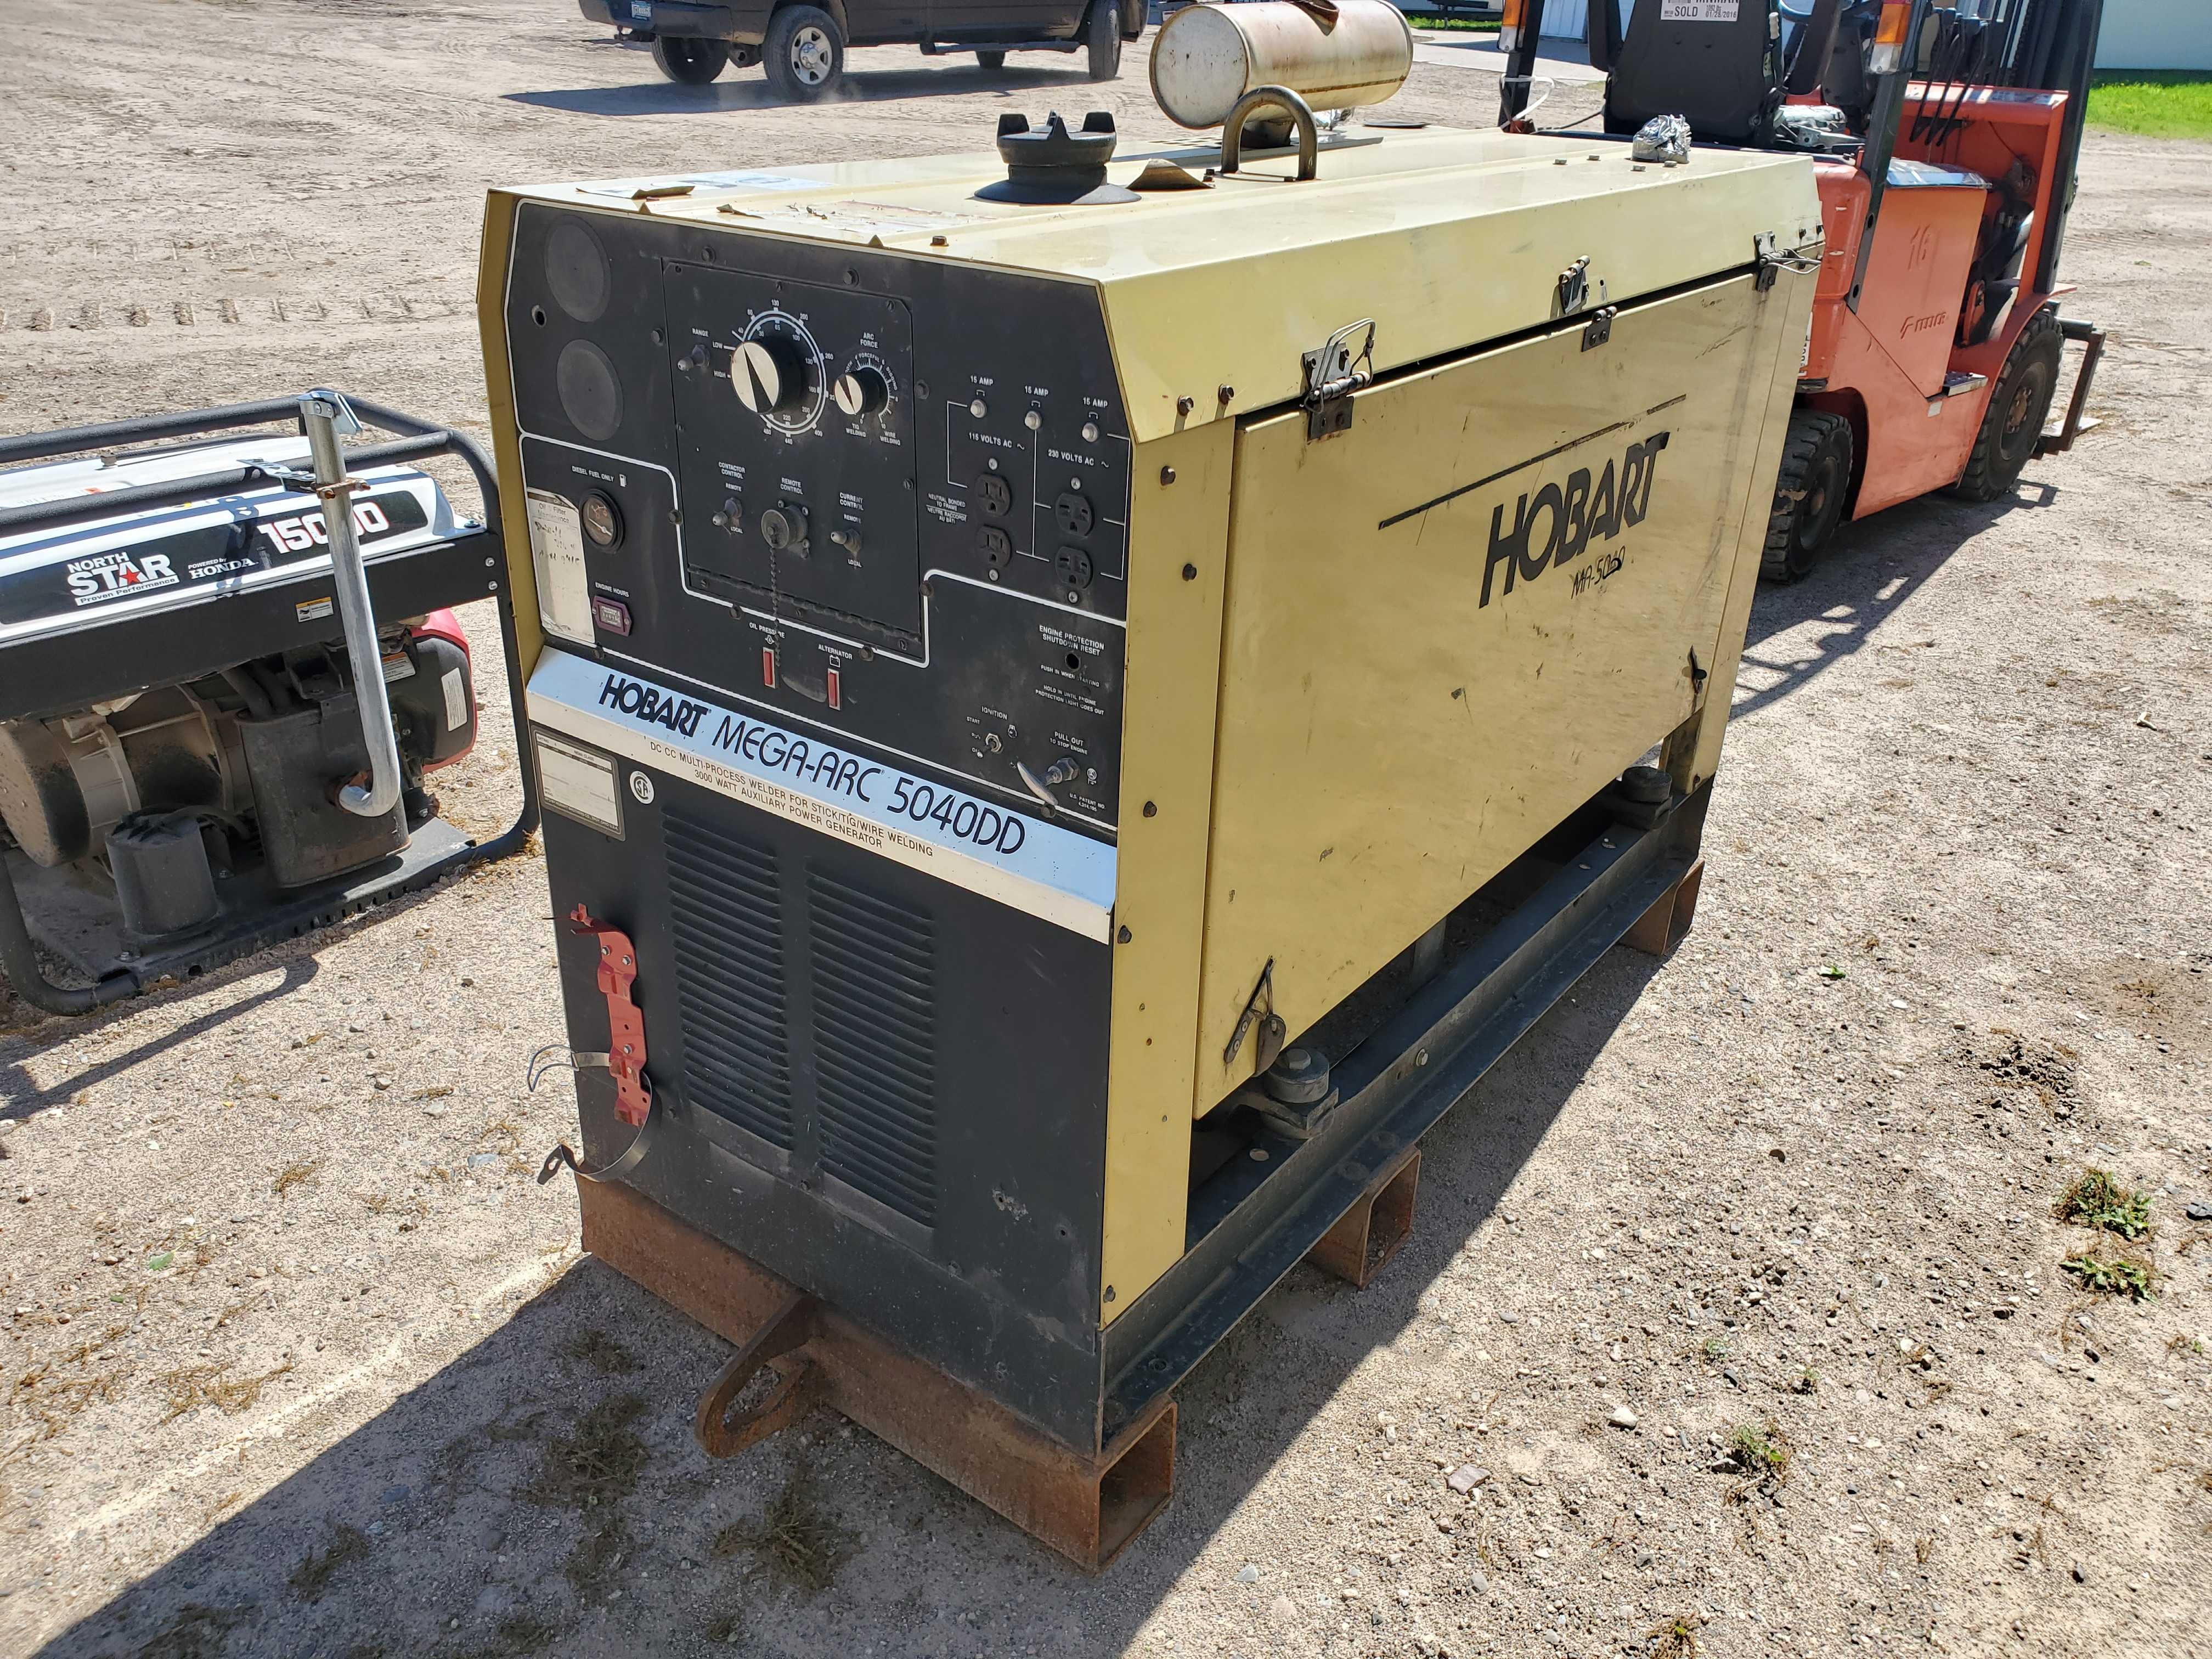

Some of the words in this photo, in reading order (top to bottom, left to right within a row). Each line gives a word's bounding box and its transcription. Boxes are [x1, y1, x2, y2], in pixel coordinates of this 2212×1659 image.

[1674, 6, 1698, 17] SOLD
[692, 328, 709, 337] RANGE
[863, 332, 874, 340] ARC
[860, 339, 878, 348] FORCE
[859, 352, 880, 363] FORCEFUL
[970, 375, 977, 383] 15
[978, 377, 994, 386] AMP
[1024, 386, 1031, 394] 15
[1033, 387, 1048, 397] AMP
[1082, 397, 1090, 405] 15
[1092, 399, 1108, 409] AMP
[845, 427, 866, 437] WELDING
[884, 430, 896, 438] WIRE
[880, 436, 900, 445] WELDING
[968, 432, 979, 442] 115
[980, 435, 1002, 446] VOLTS
[1002, 439, 1012, 448] AC
[1048, 449, 1059, 459] 230
[1061, 452, 1083, 464] VOLTS
[1084, 456, 1094, 466] AC
[719, 461, 746, 473] CONTACTOR
[572, 466, 588, 476] DIESEL
[589, 470, 601, 479] FUEL
[601, 473, 614, 482] ONLY
[721, 469, 743, 479] CONTROL
[726, 483, 742, 492] REMOTE
[781, 477, 801, 487] REMOTE
[780, 484, 803, 494] CONTROL
[839, 492, 864, 504] CURRENT
[928, 493, 947, 503] NEUTRAL
[948, 498, 966, 507] BONDED
[839, 499, 864, 511] CONTROL
[944, 503, 957, 511] FRAME
[927, 507, 943, 516] NEUTRE
[1479, 432, 1670, 610] HOBART
[257, 502, 389, 554] 1500
[67, 552, 129, 573] NORTH
[188, 560, 218, 570] POWERED
[67, 554, 176, 596] STAR
[189, 559, 256, 579] HONDA
[80, 592, 114, 603] Proven
[116, 578, 176, 595] Performance
[595, 582, 612, 592] ENGINE
[613, 586, 630, 597] HOURS
[1039, 625, 1063, 638] ENGINE
[1064, 633, 1104, 650] PROTECTION
[818, 644, 853, 659] ALTERNATOR
[1041, 664, 1053, 673] PUSH
[1060, 670, 1075, 679] WHEN
[1035, 689, 1064, 703] PROTECTION
[1043, 685, 1057, 693] HOLD
[1064, 691, 1077, 700] UNTIL
[981, 706, 1008, 720] IGNITION
[966, 716, 980, 724] START
[1054, 731, 1069, 742] PULL
[1071, 737, 1084, 747] OUT
[1057, 740, 1069, 748] STOP
[1070, 744, 1088, 755] ENGINE
[599, 674, 709, 737] HOBART
[712, 715, 882, 803] MEGA-ARC
[887, 777, 1025, 855] 5040DD
[650, 741, 662, 753] DC
[664, 746, 677, 759] CC
[748, 774, 787, 800] WELDER
[789, 794, 809, 810] FOR
[811, 803, 884, 838] STICK/TIG/WIRE
[887, 832, 934, 856] WELDING
[1079, 796, 1096, 806] PATENT
[694, 769, 713, 783] 3000
[715, 776, 738, 792] WATT
[740, 785, 786, 811] AUXILIARY
[789, 806, 823, 828] POWER
[826, 819, 883, 849] GENERATOR
